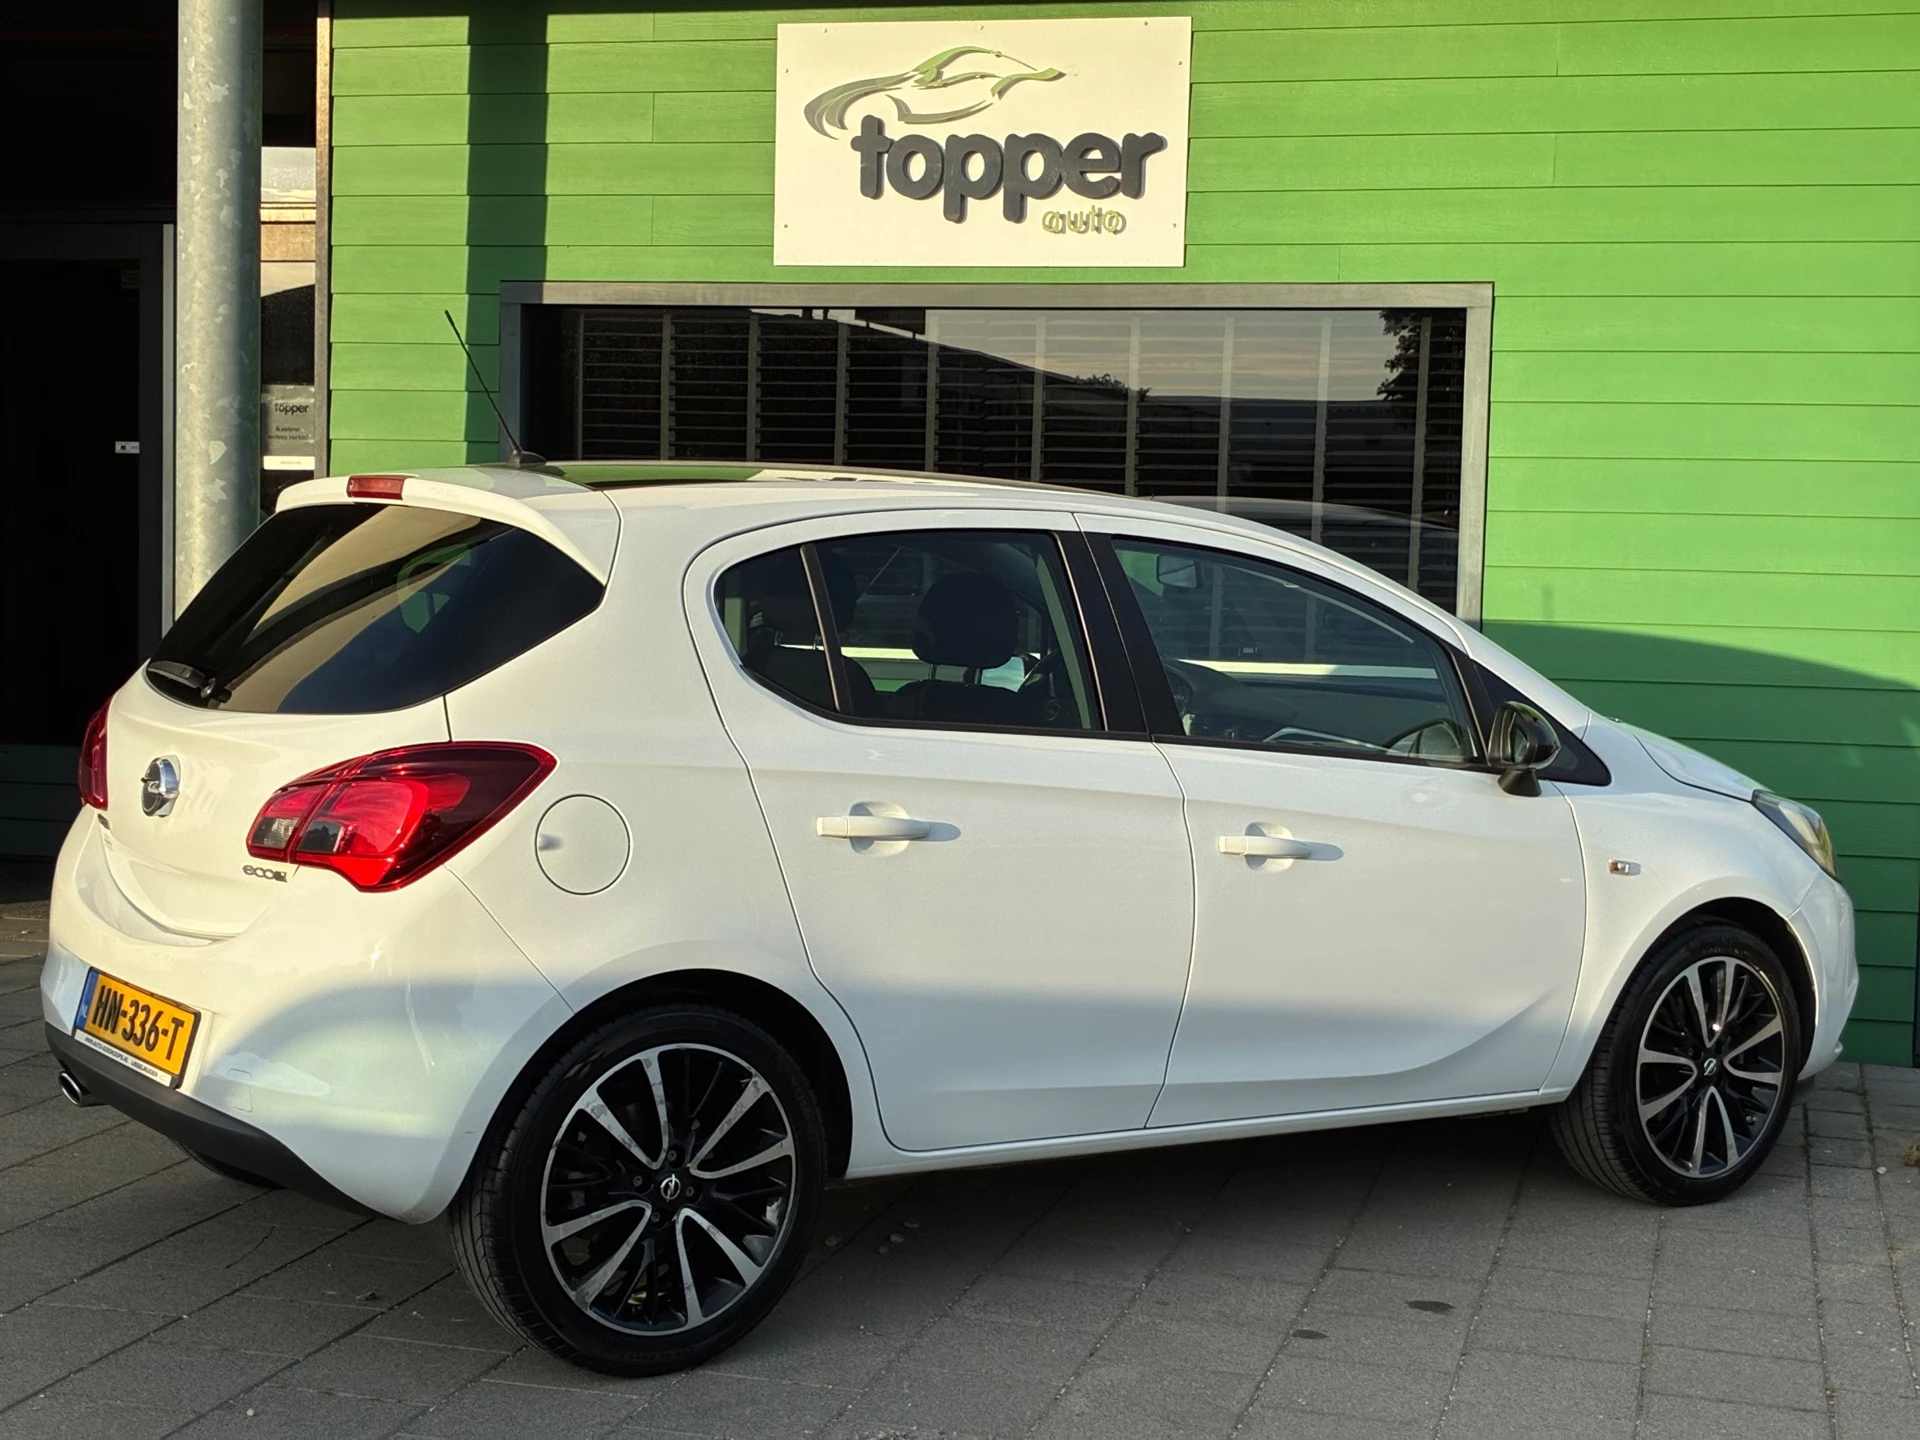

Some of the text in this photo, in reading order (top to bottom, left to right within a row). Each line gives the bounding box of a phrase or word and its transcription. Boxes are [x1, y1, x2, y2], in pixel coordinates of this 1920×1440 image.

[850, 114, 1167, 224] topper
[1041, 205, 1124, 235] auto
[91, 984, 185, 1062] HN-336-T
